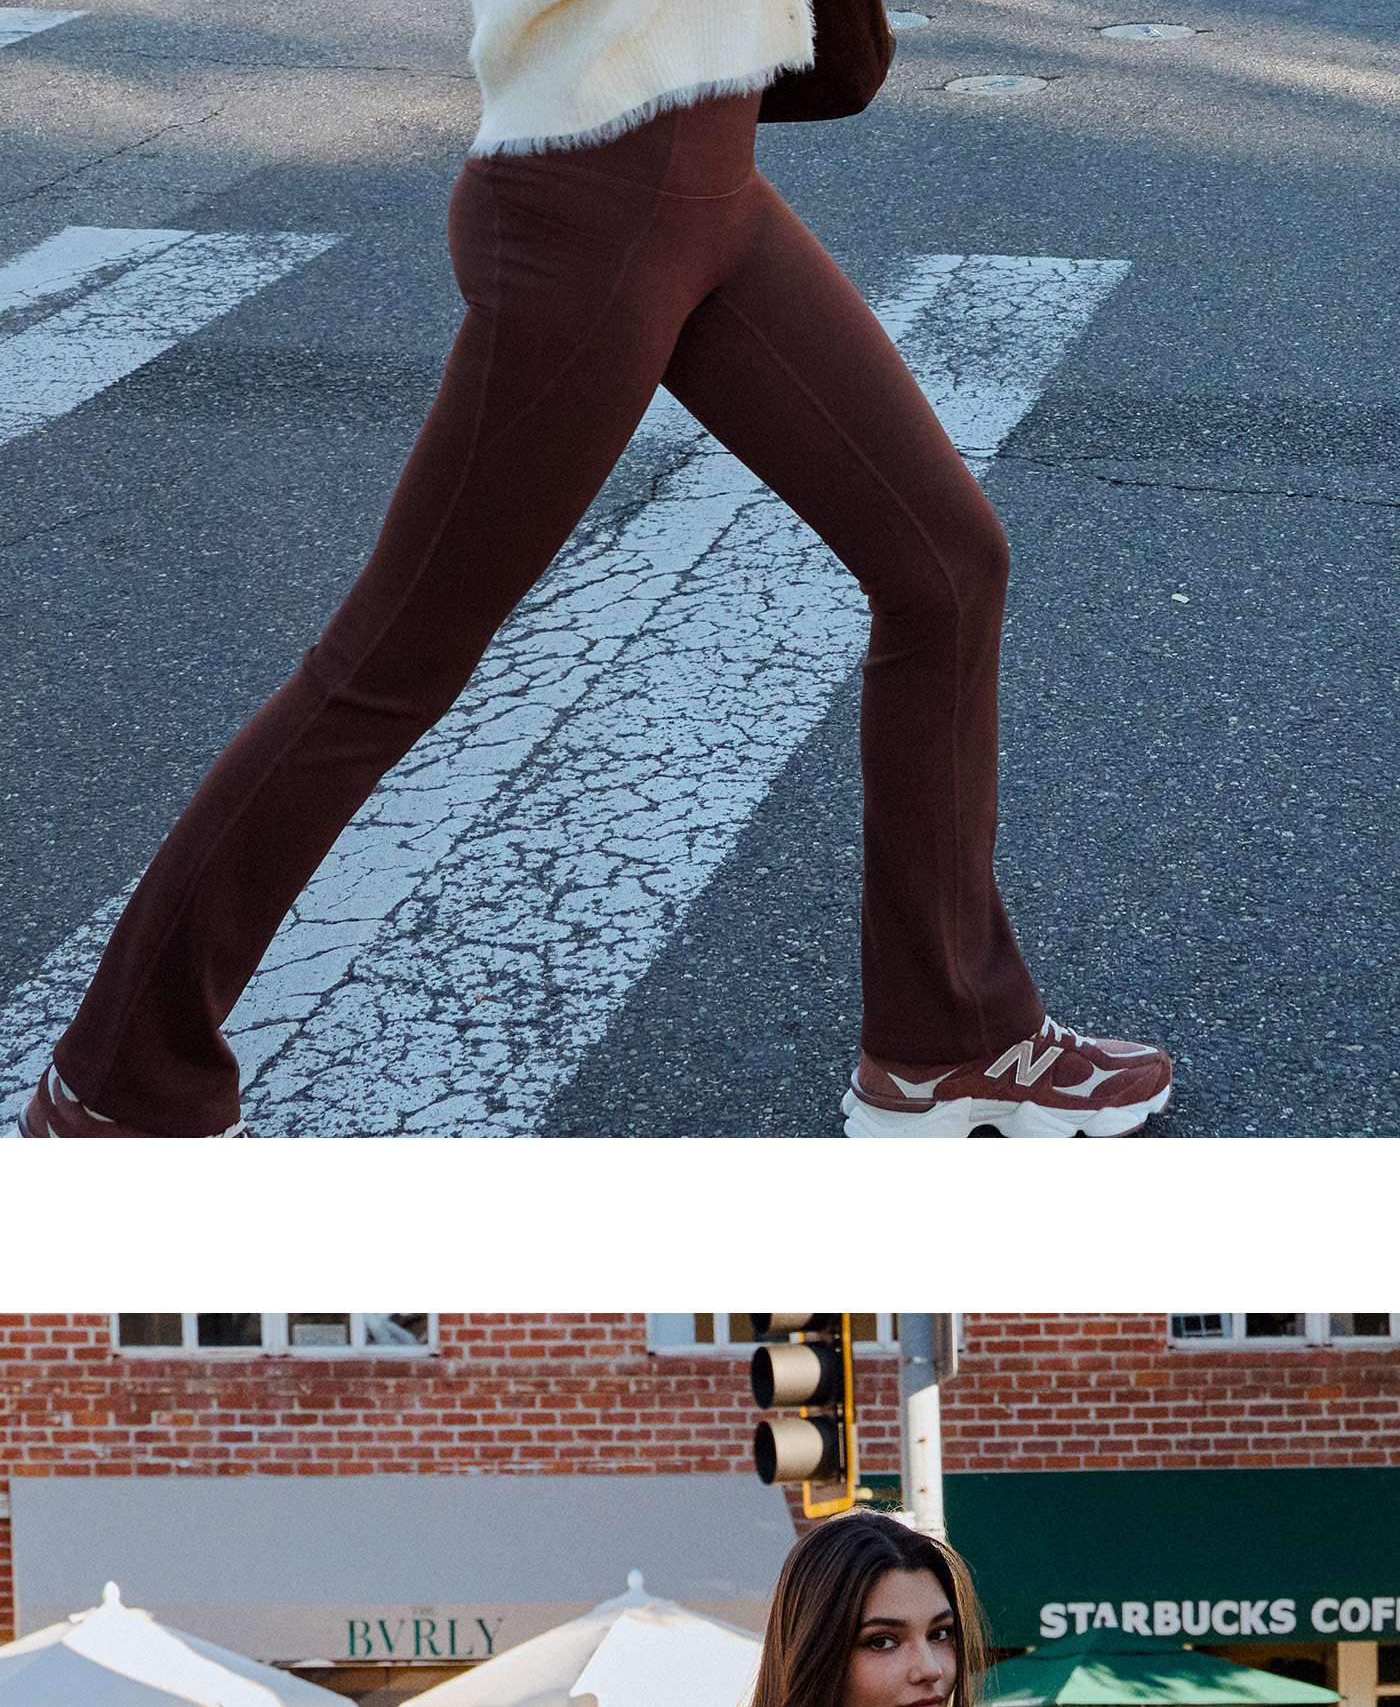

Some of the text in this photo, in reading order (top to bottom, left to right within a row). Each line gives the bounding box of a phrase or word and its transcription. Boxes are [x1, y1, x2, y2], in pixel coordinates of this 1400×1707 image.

[347, 1618, 503, 1657] BVRLY
[1039, 1597, 1400, 1639] STARBUCKS COF
